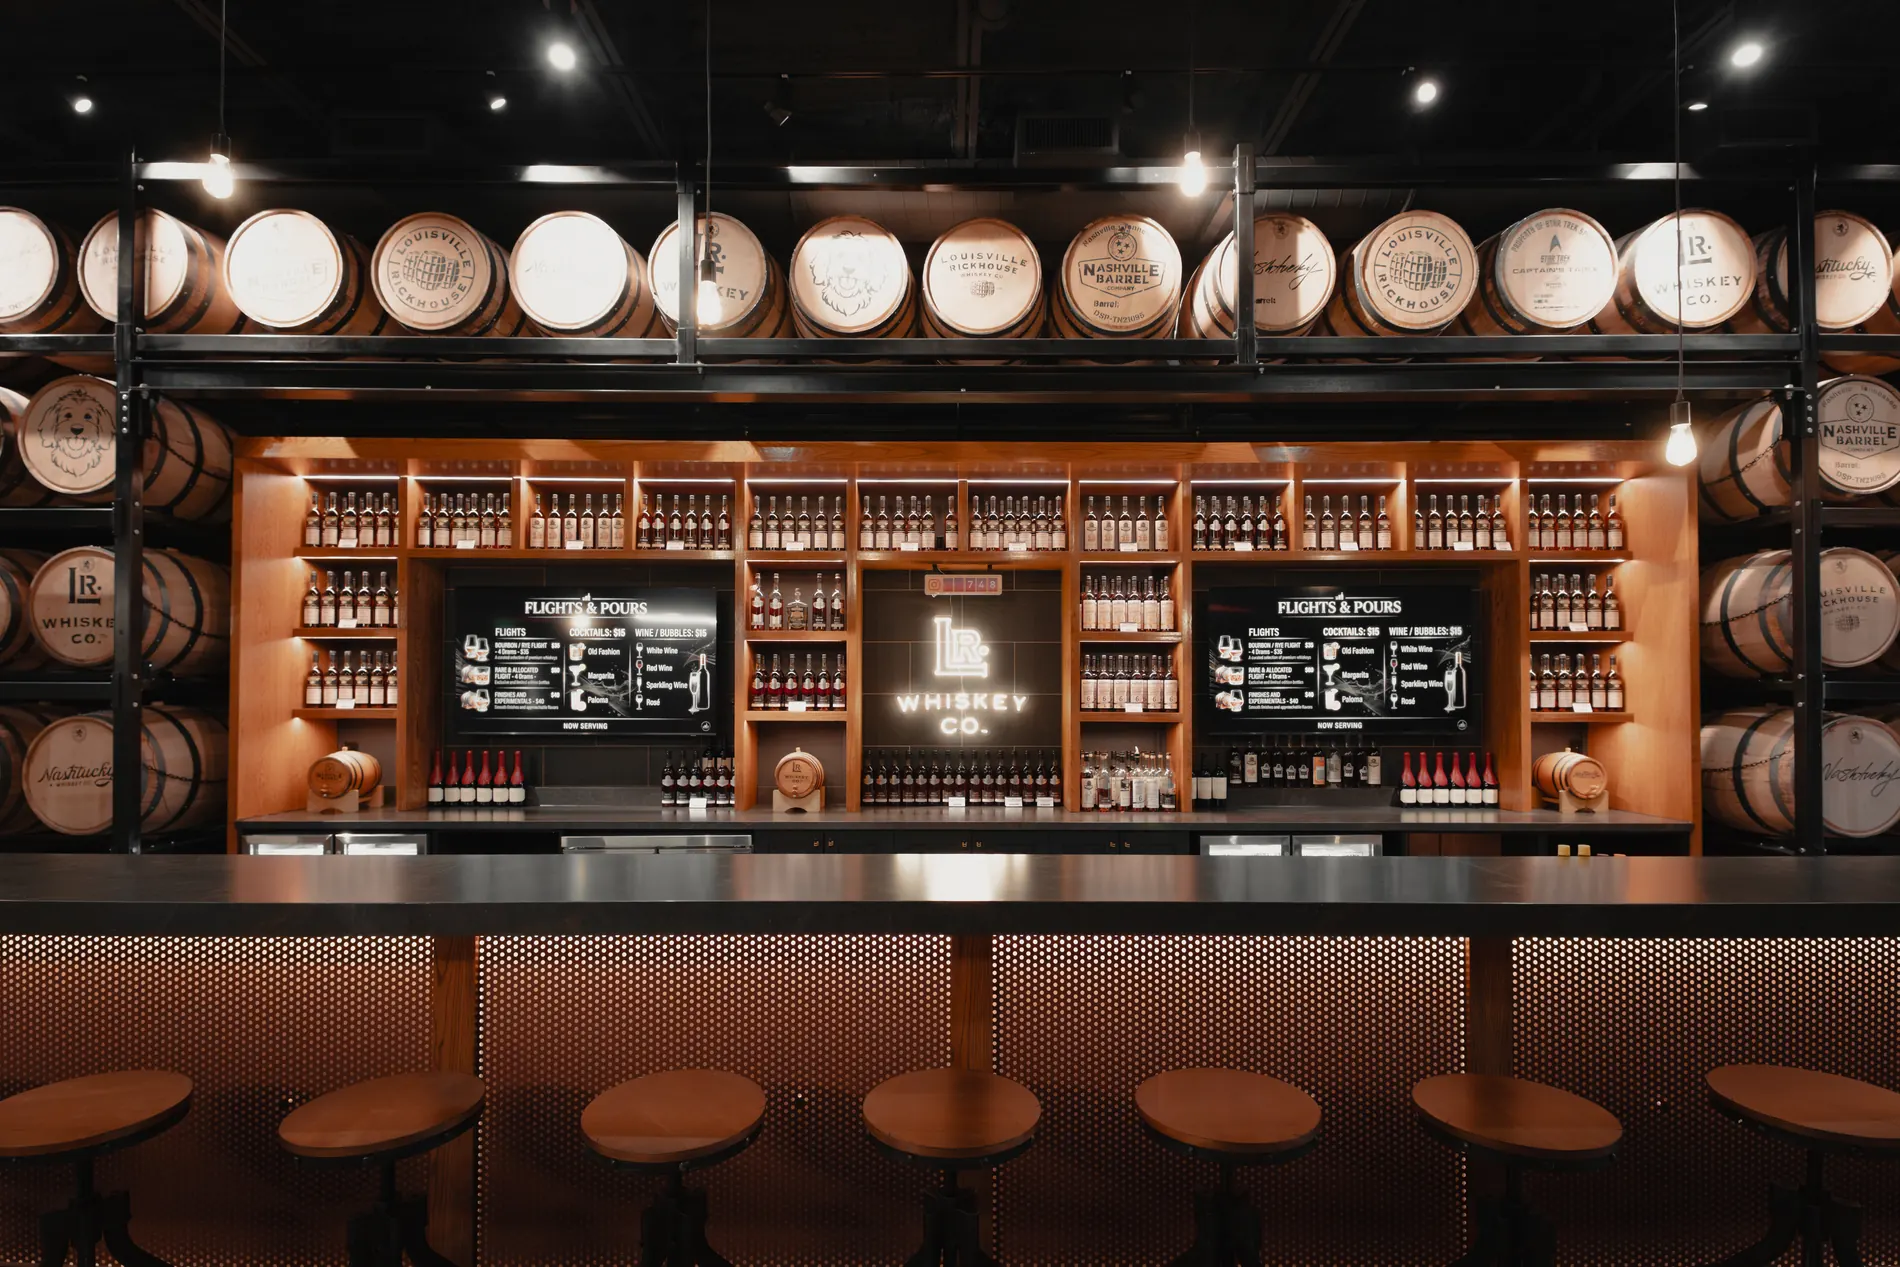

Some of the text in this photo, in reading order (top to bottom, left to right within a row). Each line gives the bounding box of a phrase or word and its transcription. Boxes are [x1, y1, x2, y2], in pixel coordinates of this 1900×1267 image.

[397, 230, 471, 268] LOUISVILLE
[1382, 230, 1458, 266] LOUISVILLE
[941, 252, 1028, 267] LOUISVILLE
[949, 263, 1018, 275] RICKHOUSE
[1083, 264, 1160, 277] NASHVILLE
[1096, 275, 1149, 284] BARREL
[391, 271, 467, 309] RICKHOUSE
[1655, 276, 1742, 294] WHISKEY
[1378, 273, 1455, 309] RICKHOUSE
[1686, 294, 1718, 306] CO.
[1823, 425, 1897, 439] NASHVILLE
[1836, 436, 1888, 446] BARREL
[1820, 586, 1886, 598] UISVILLE
[1278, 600, 1402, 614] FLIGHTS & POURS
[1821, 596, 1880, 608] CKHOUSE
[525, 601, 648, 615] FLIGHTS & POURS
[42, 617, 115, 629] WHISKE
[495, 627, 527, 637] FLIGHTS
[569, 628, 626, 637] COCKTAILS: $15
[634, 628, 654, 637] WINE
[660, 628, 694, 637] BUBBLES:
[695, 628, 708, 638] $15
[1248, 627, 1280, 637] FLIGHTS
[1323, 626, 1380, 636] COCKTAILS: $15
[1388, 626, 1408, 636] WINE
[1414, 626, 1449, 636] BUBBLES:
[1450, 626, 1463, 636] $15
[71, 634, 102, 644] CO.
[1341, 647, 1375, 655] Old Fashion
[1401, 645, 1417, 653] White
[587, 672, 615, 681] Margarita
[1342, 671, 1369, 680] Margarita
[646, 681, 688, 690] Sparkling Wine
[1401, 680, 1428, 689] Sparkling
[587, 696, 609, 704] Paloma
[646, 698, 660, 706] Rosé
[896, 693, 1027, 712] WHISKEY
[1401, 697, 1415, 705] Rosé
[940, 717, 989, 734] CO.
[1317, 721, 1363, 729] NOW SERVING
